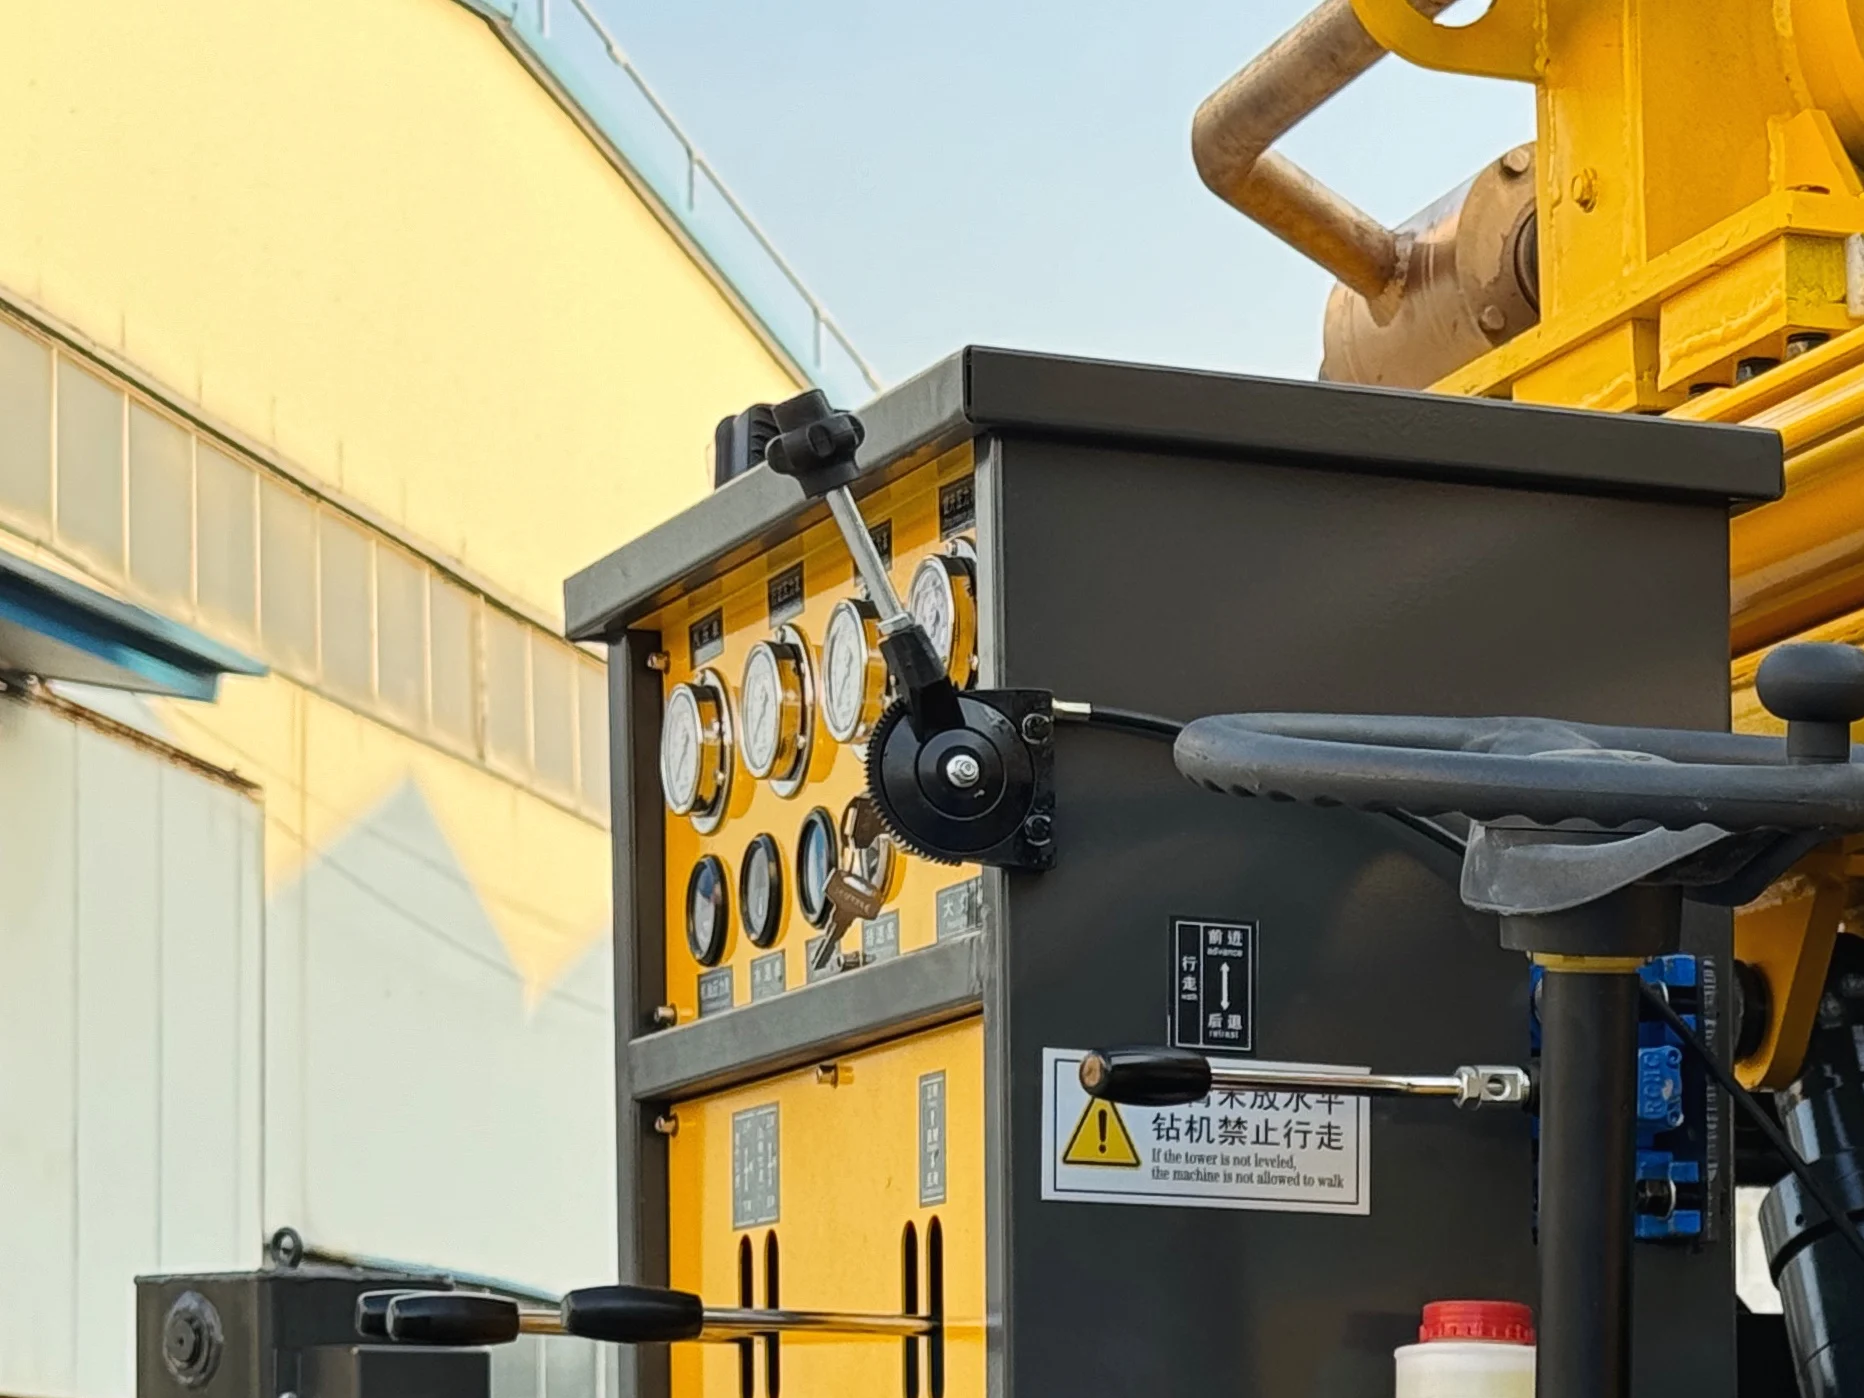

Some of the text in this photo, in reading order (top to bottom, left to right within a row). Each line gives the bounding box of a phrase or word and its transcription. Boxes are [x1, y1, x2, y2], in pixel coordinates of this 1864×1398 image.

[1207, 929, 1243, 946] 前进
[1181, 955, 1198, 991] 行走
[1207, 1012, 1243, 1030] 后退
[1151, 1111, 1345, 1151] 钻机禁止行走
[1152, 1148, 1297, 1171] If the tower is not leveled,
[1152, 1166, 1345, 1189] the machine is not allowed to walk
